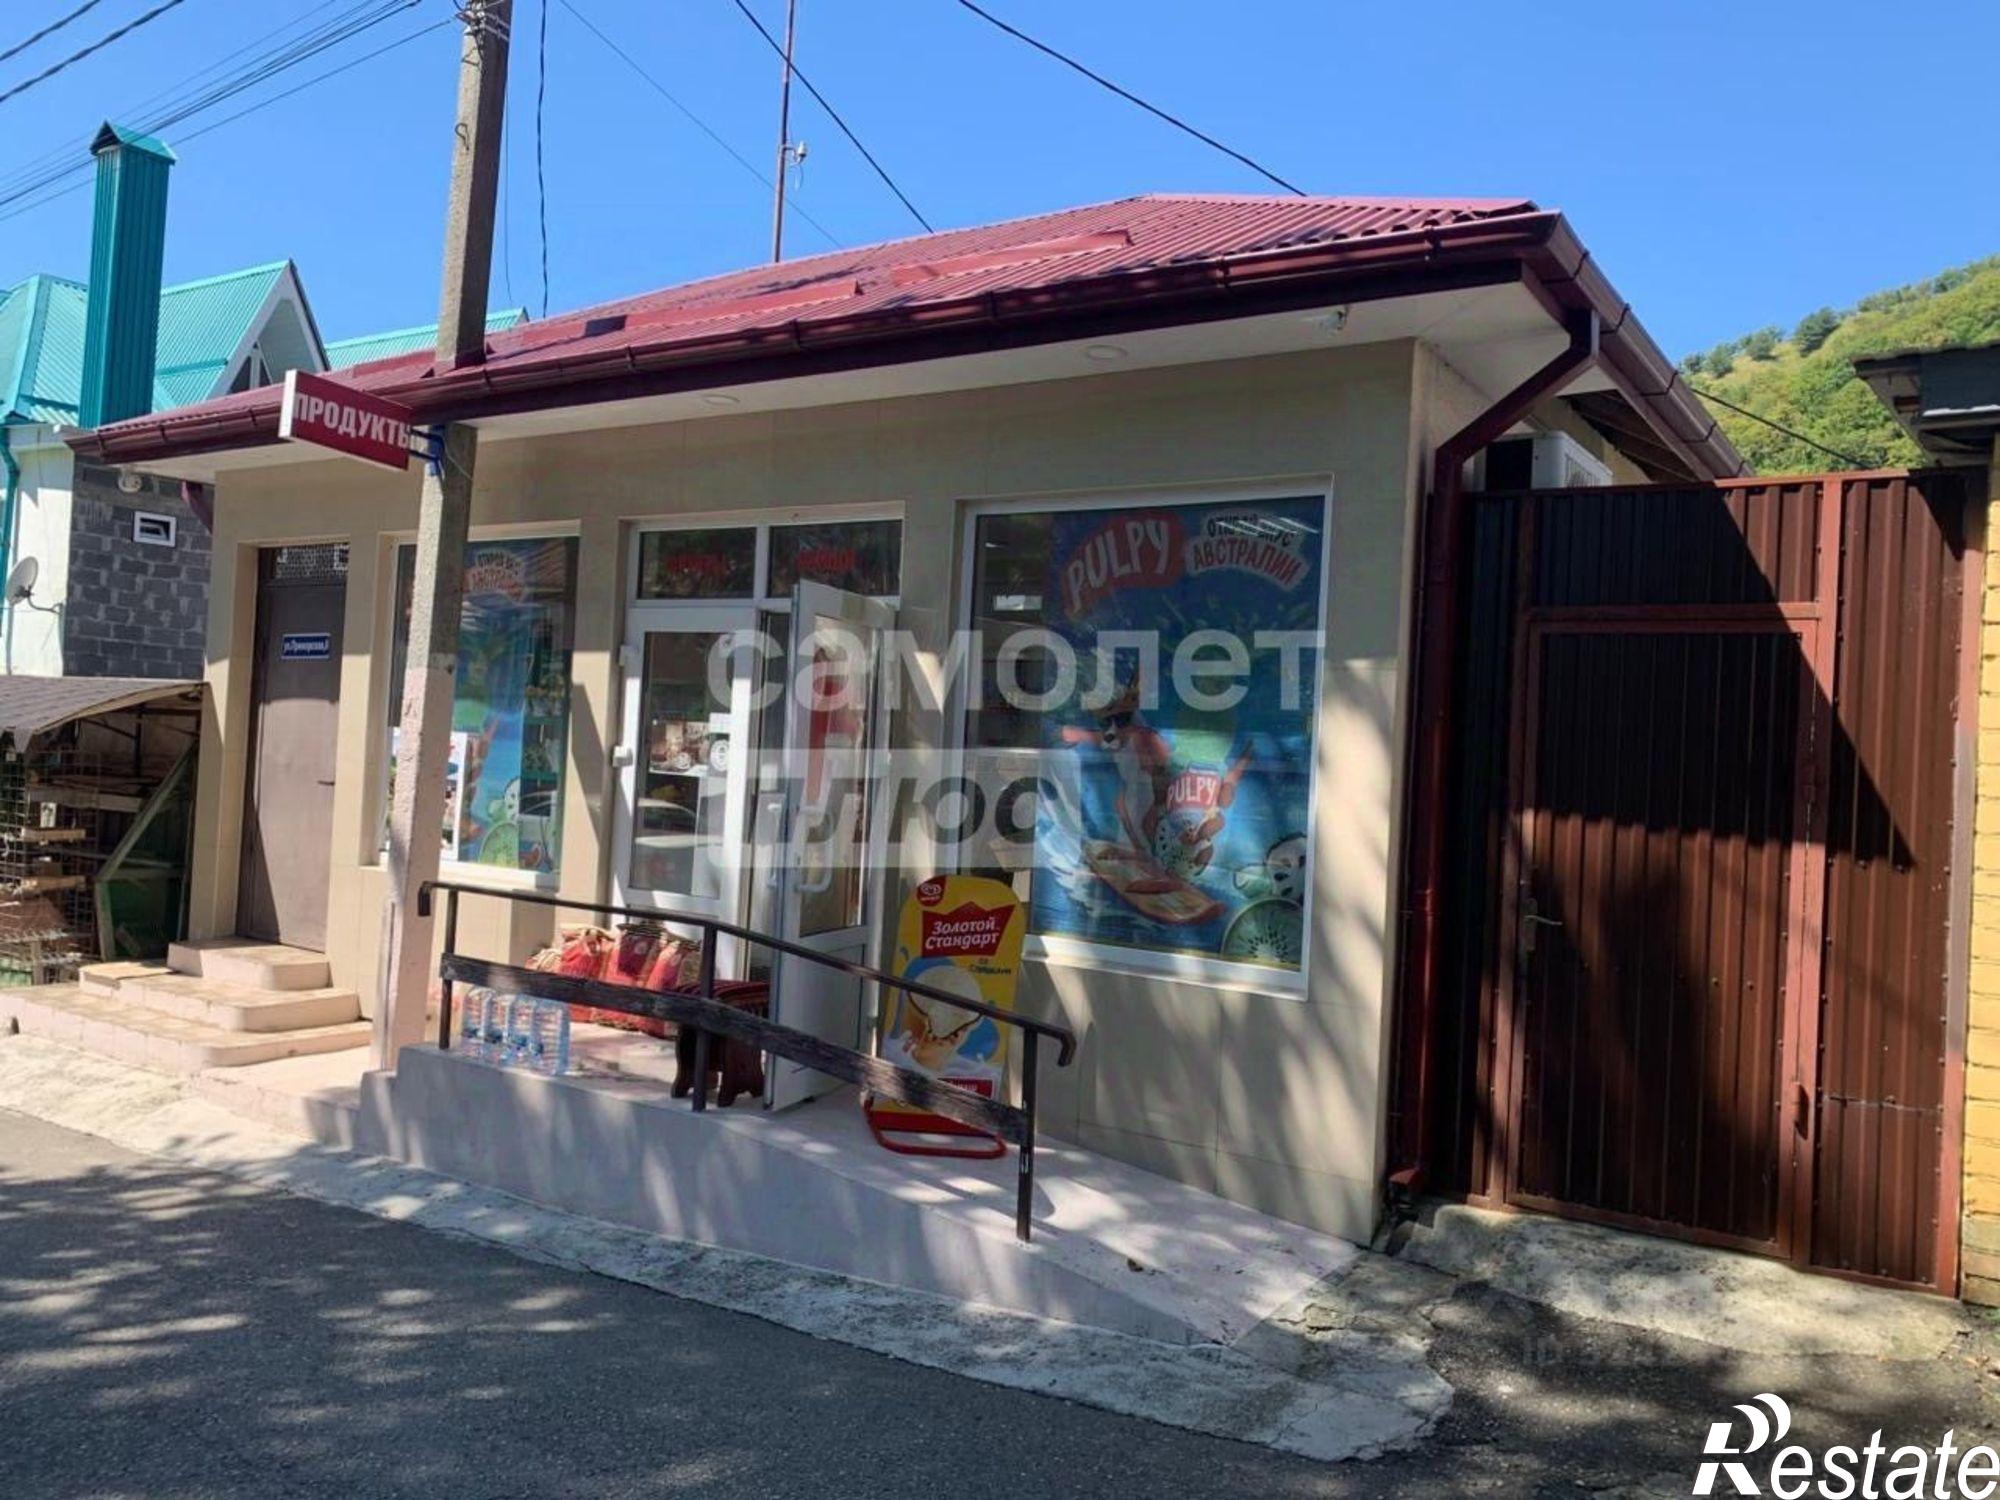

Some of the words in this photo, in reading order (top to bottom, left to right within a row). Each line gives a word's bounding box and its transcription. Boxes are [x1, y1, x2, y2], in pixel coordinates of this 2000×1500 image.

[293, 391, 411, 450] ПРОДУКТЫ
[1067, 518, 1170, 614] PULPY
[1192, 537, 1303, 587] АВСТРАЛИИ
[1166, 775, 1218, 812] PULPY
[925, 932, 1000, 951] Стандарт
[932, 916, 996, 936] Золотой
